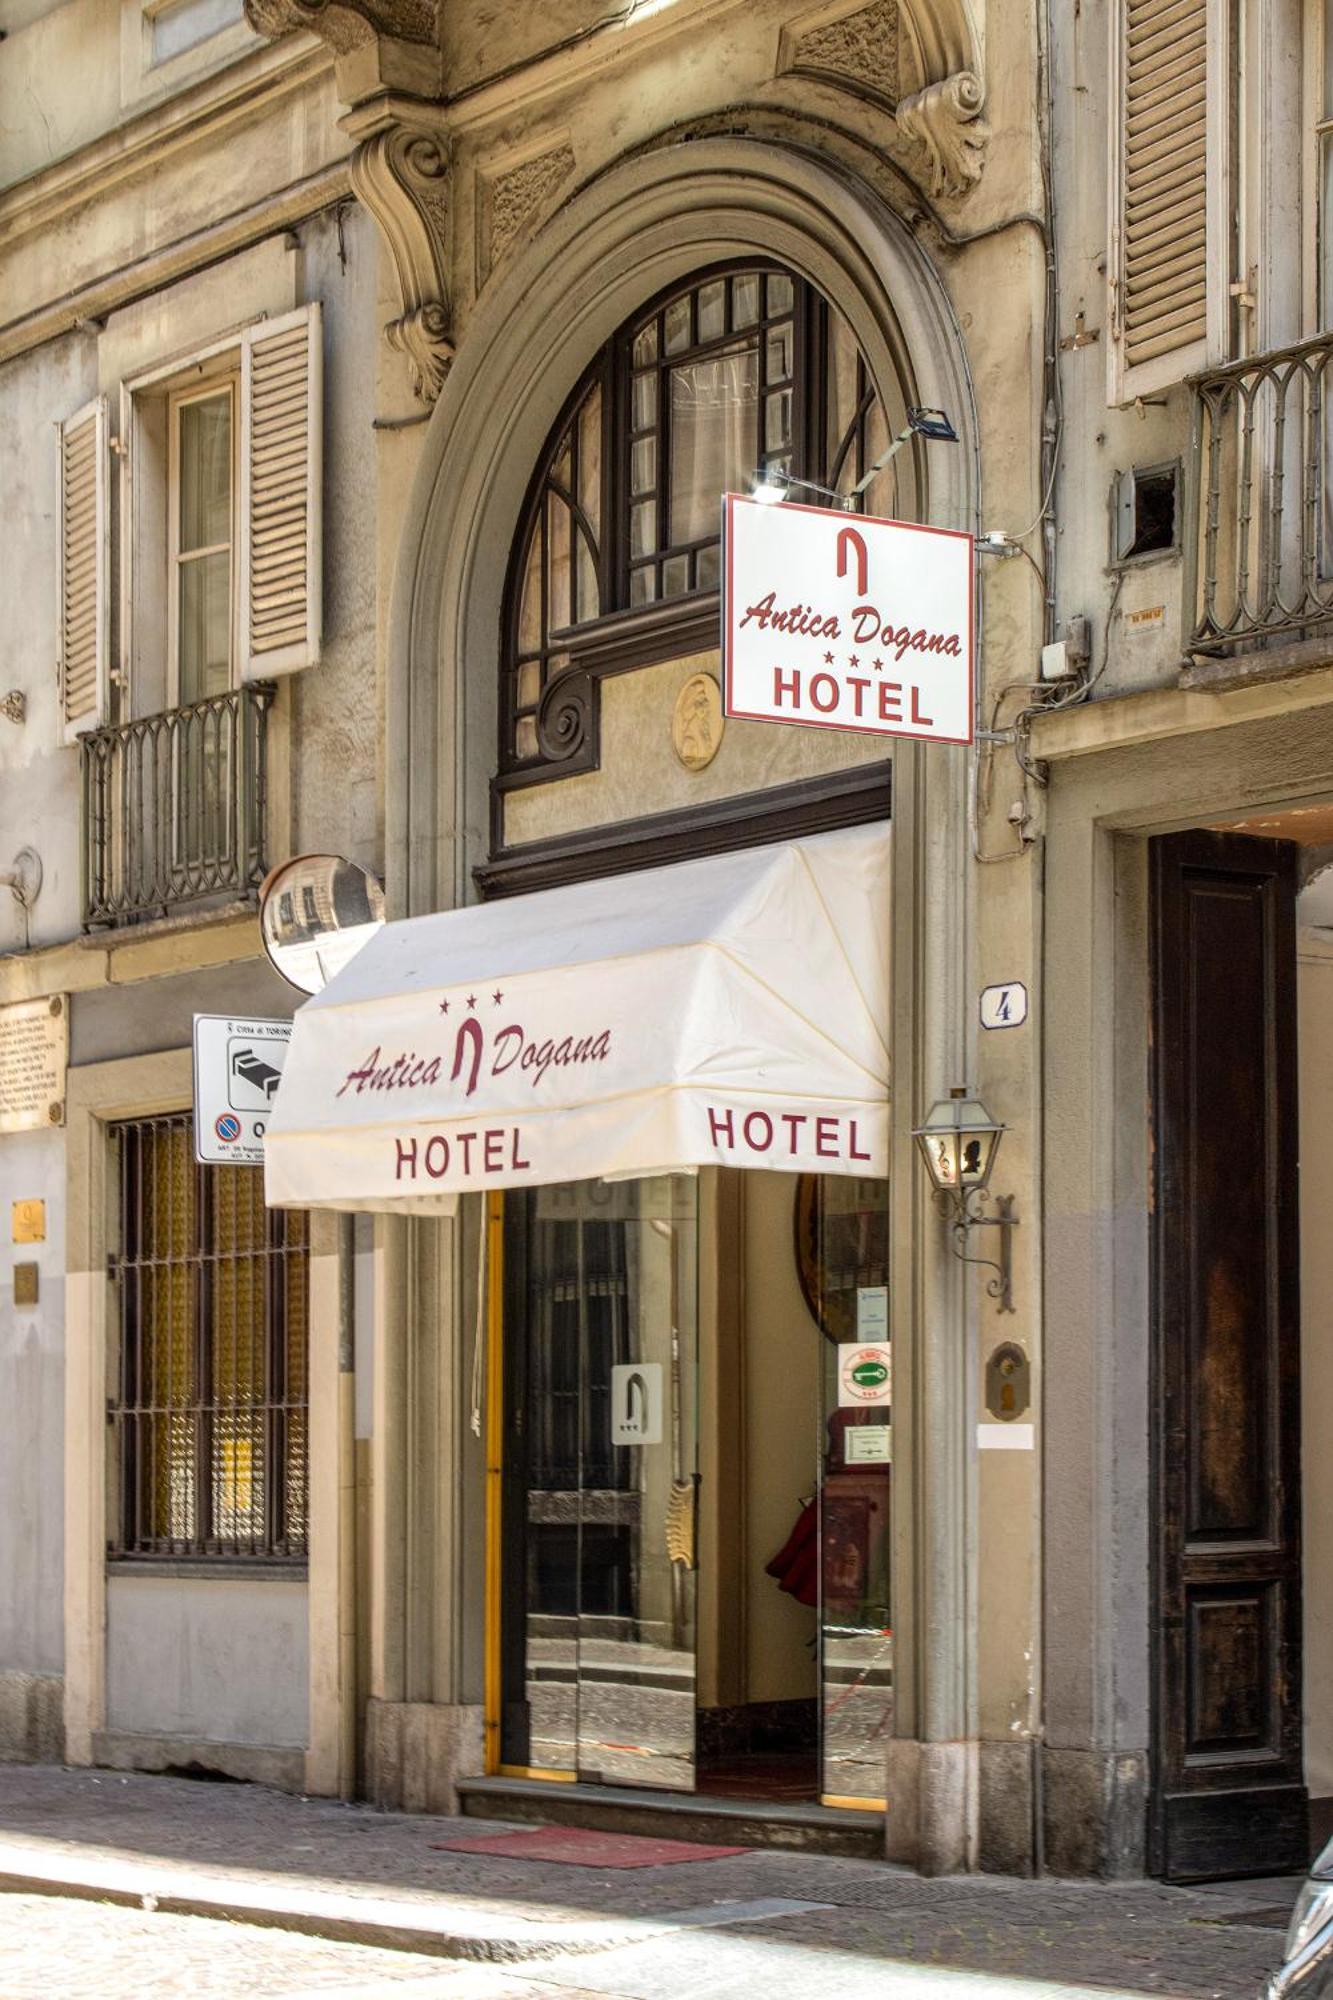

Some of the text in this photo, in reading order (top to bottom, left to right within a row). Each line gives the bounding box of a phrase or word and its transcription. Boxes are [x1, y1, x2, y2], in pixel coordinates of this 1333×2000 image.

[739, 592, 962, 661] Antica Dogana
[774, 667, 933, 726] HOTEL
[995, 991, 1012, 1021] 4
[336, 1024, 611, 1098] Antica Dogana
[395, 1128, 530, 1180] HOTEL
[708, 1107, 871, 1160] HOTEL
